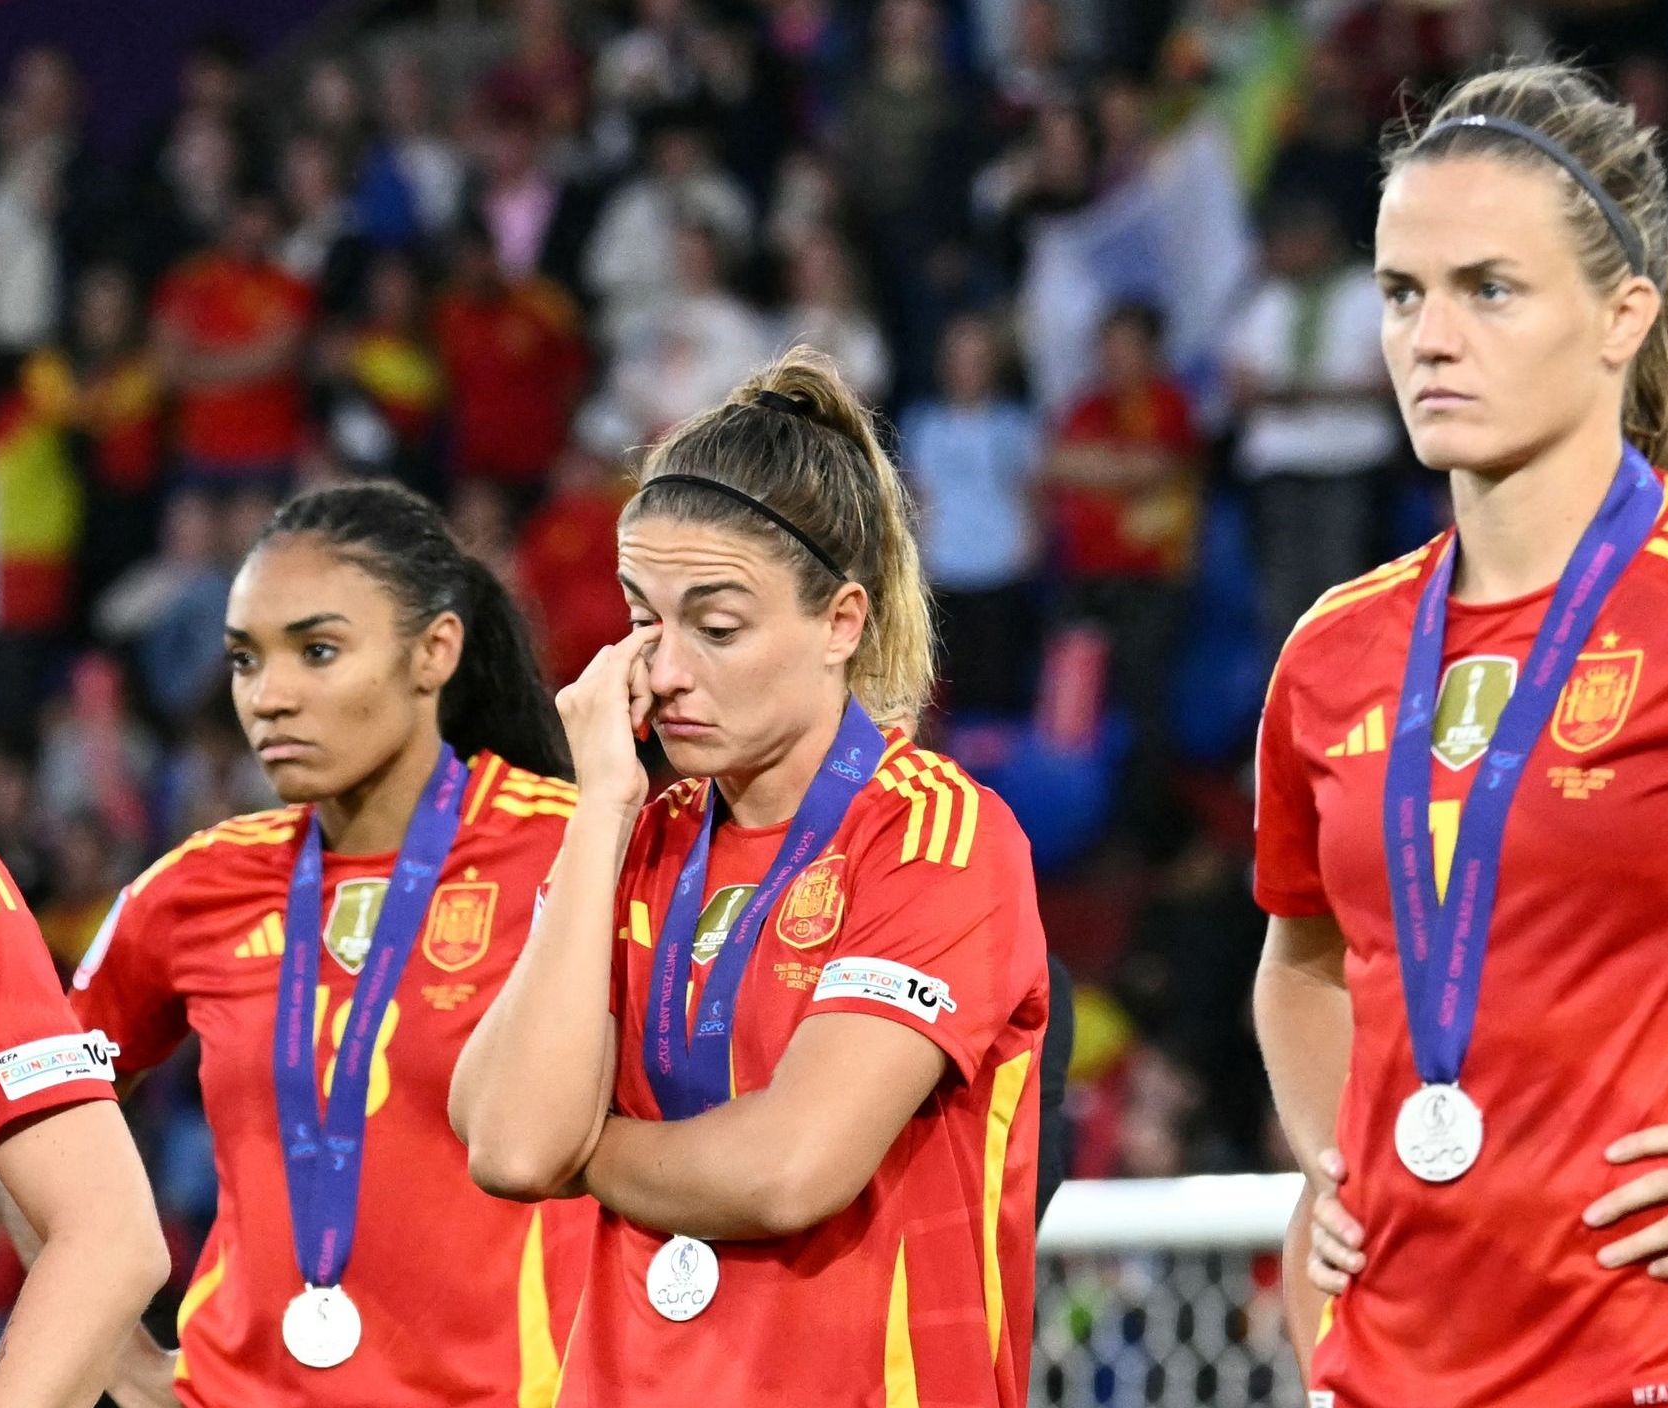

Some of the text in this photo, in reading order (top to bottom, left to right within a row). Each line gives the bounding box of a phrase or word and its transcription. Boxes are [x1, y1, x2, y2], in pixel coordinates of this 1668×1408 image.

[658, 943, 678, 1035] SWITZERLAND
[907, 978, 938, 1008] 10
[0, 1051, 86, 1083] FOUNDATION
